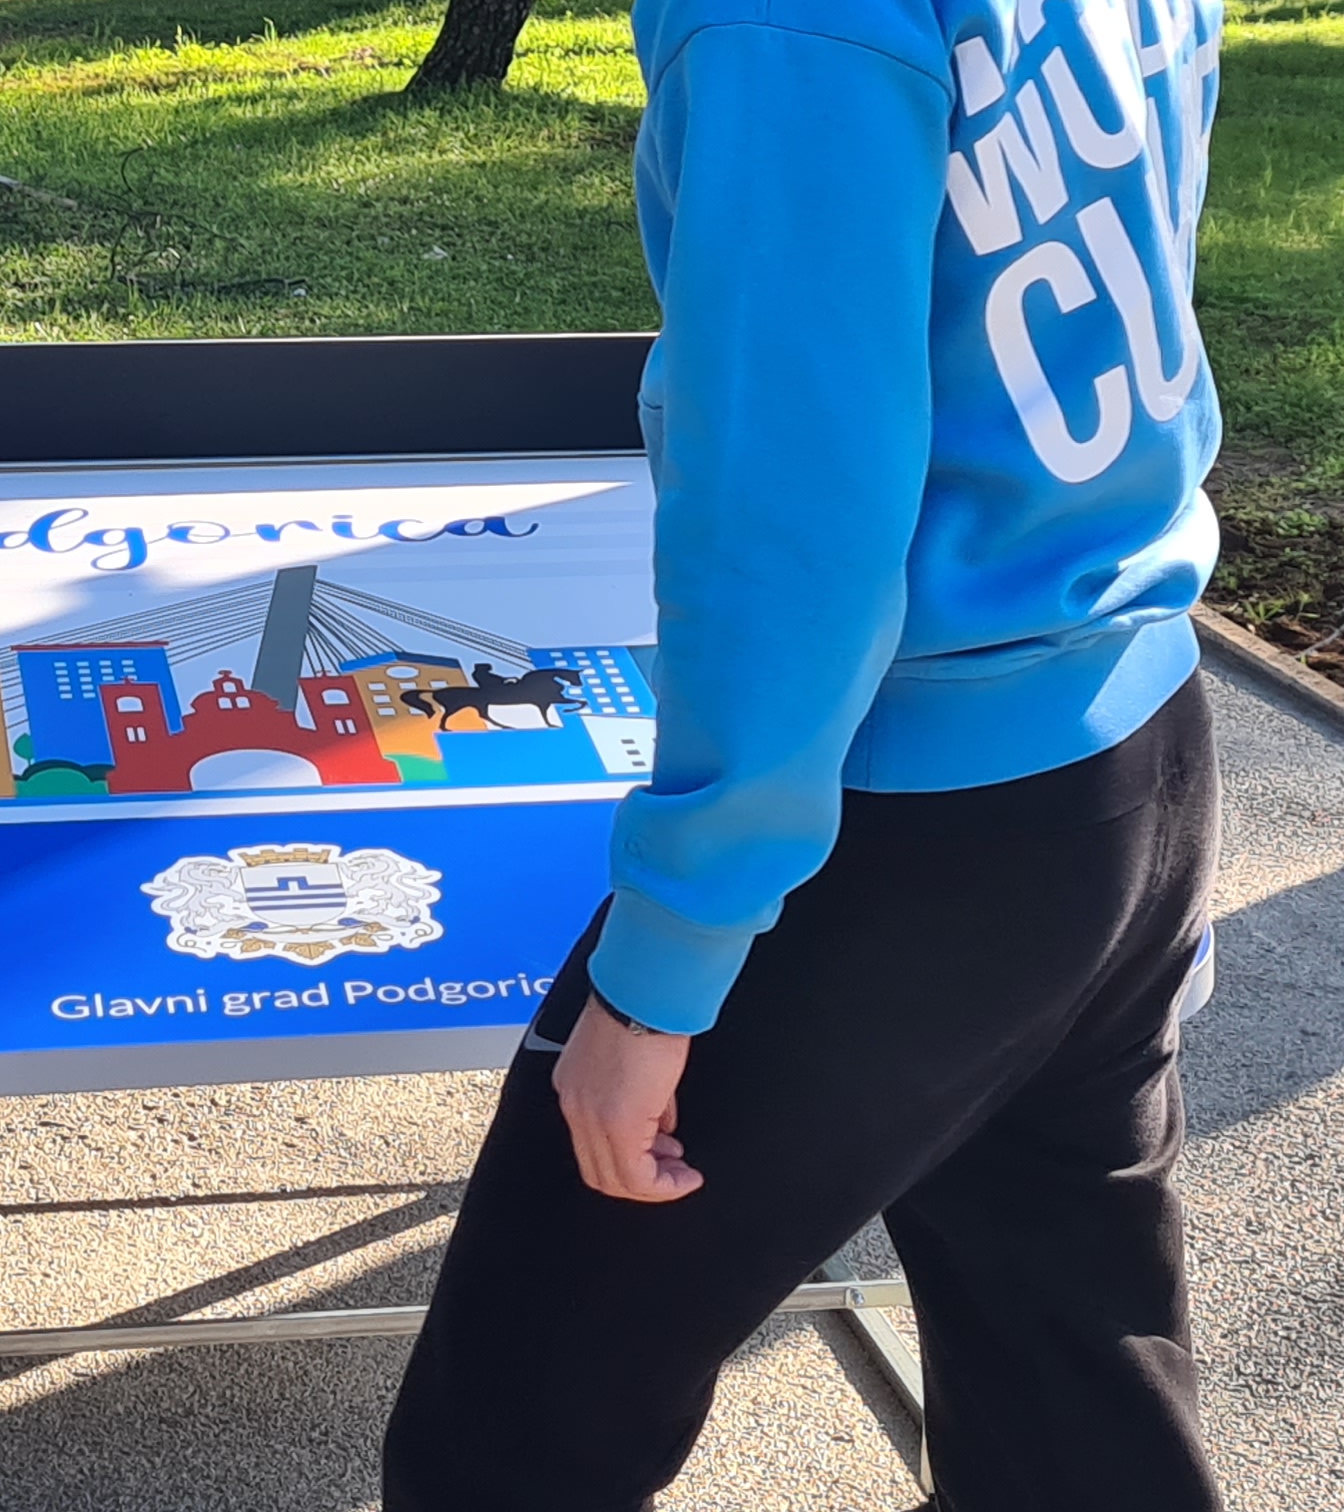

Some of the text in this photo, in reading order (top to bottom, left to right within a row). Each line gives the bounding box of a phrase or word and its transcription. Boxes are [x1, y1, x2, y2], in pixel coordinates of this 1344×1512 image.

[51, 971, 554, 1020] Glavni grad Podgoric
